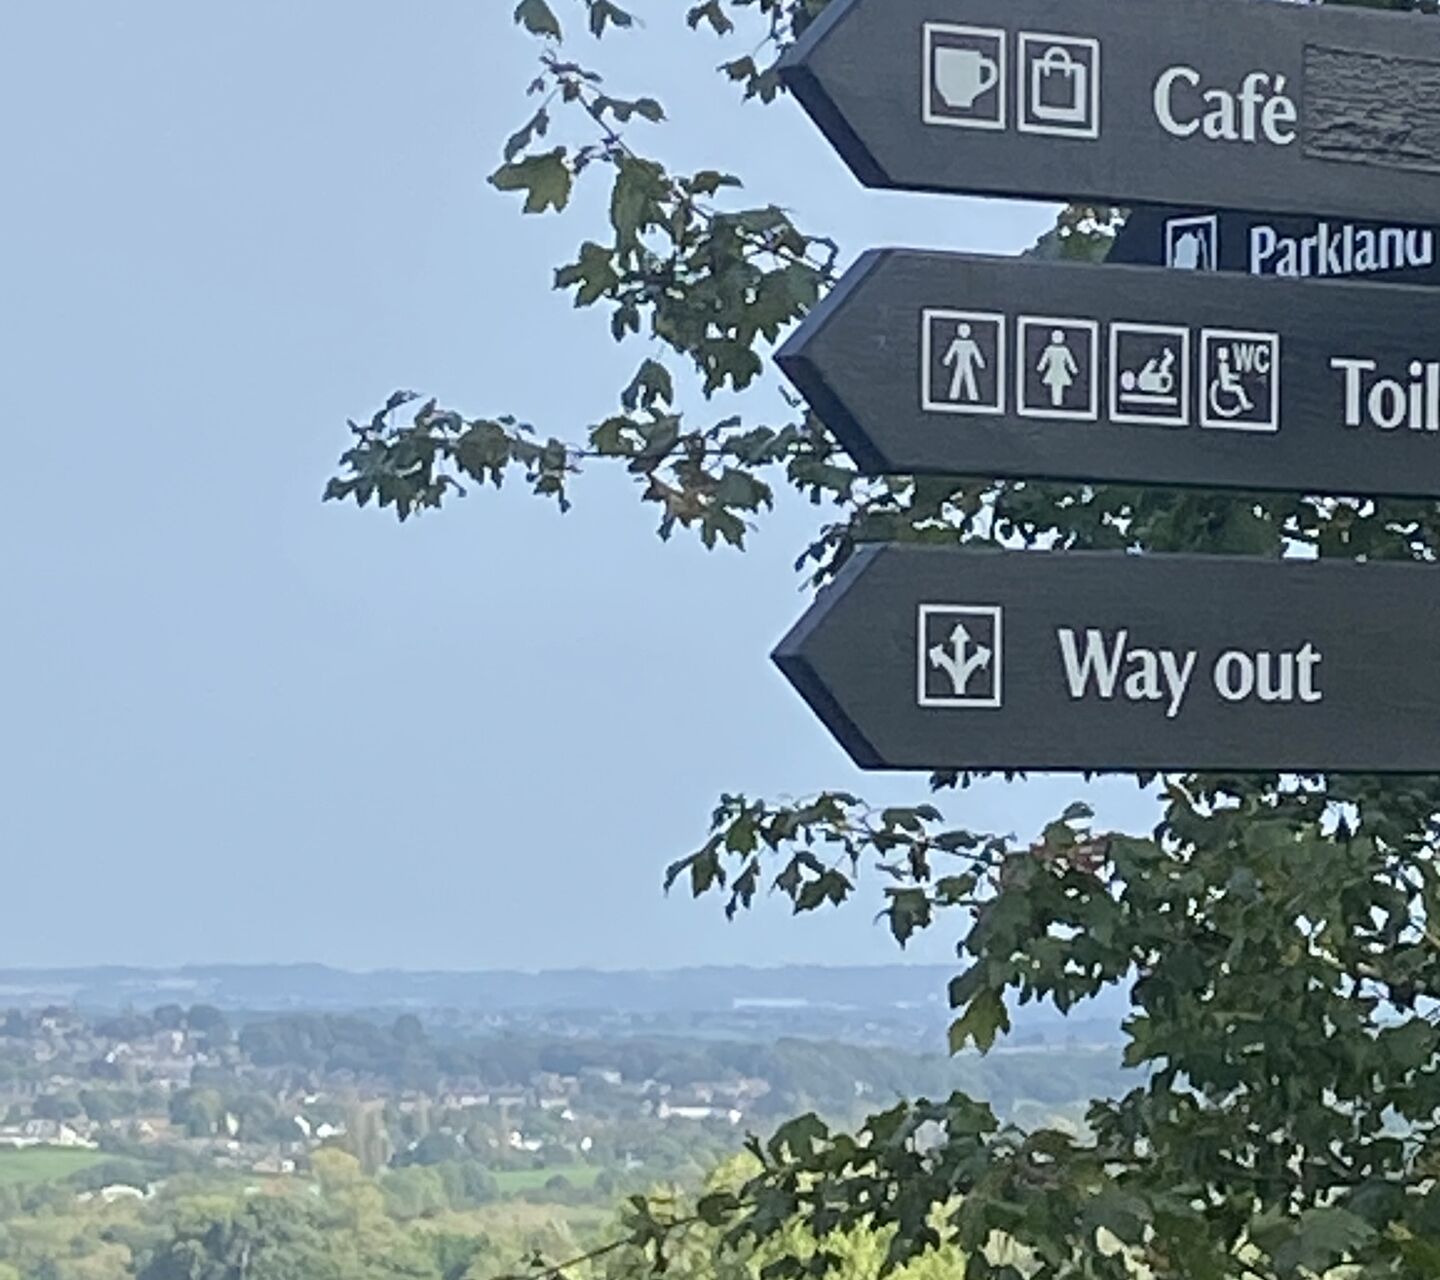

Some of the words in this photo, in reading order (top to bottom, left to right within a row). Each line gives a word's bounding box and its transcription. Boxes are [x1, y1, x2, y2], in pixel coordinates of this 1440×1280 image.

[1154, 67, 1297, 145] Café
[1231, 342, 1271, 374] WC
[1058, 628, 1197, 718] Way
[1214, 643, 1322, 702] out
